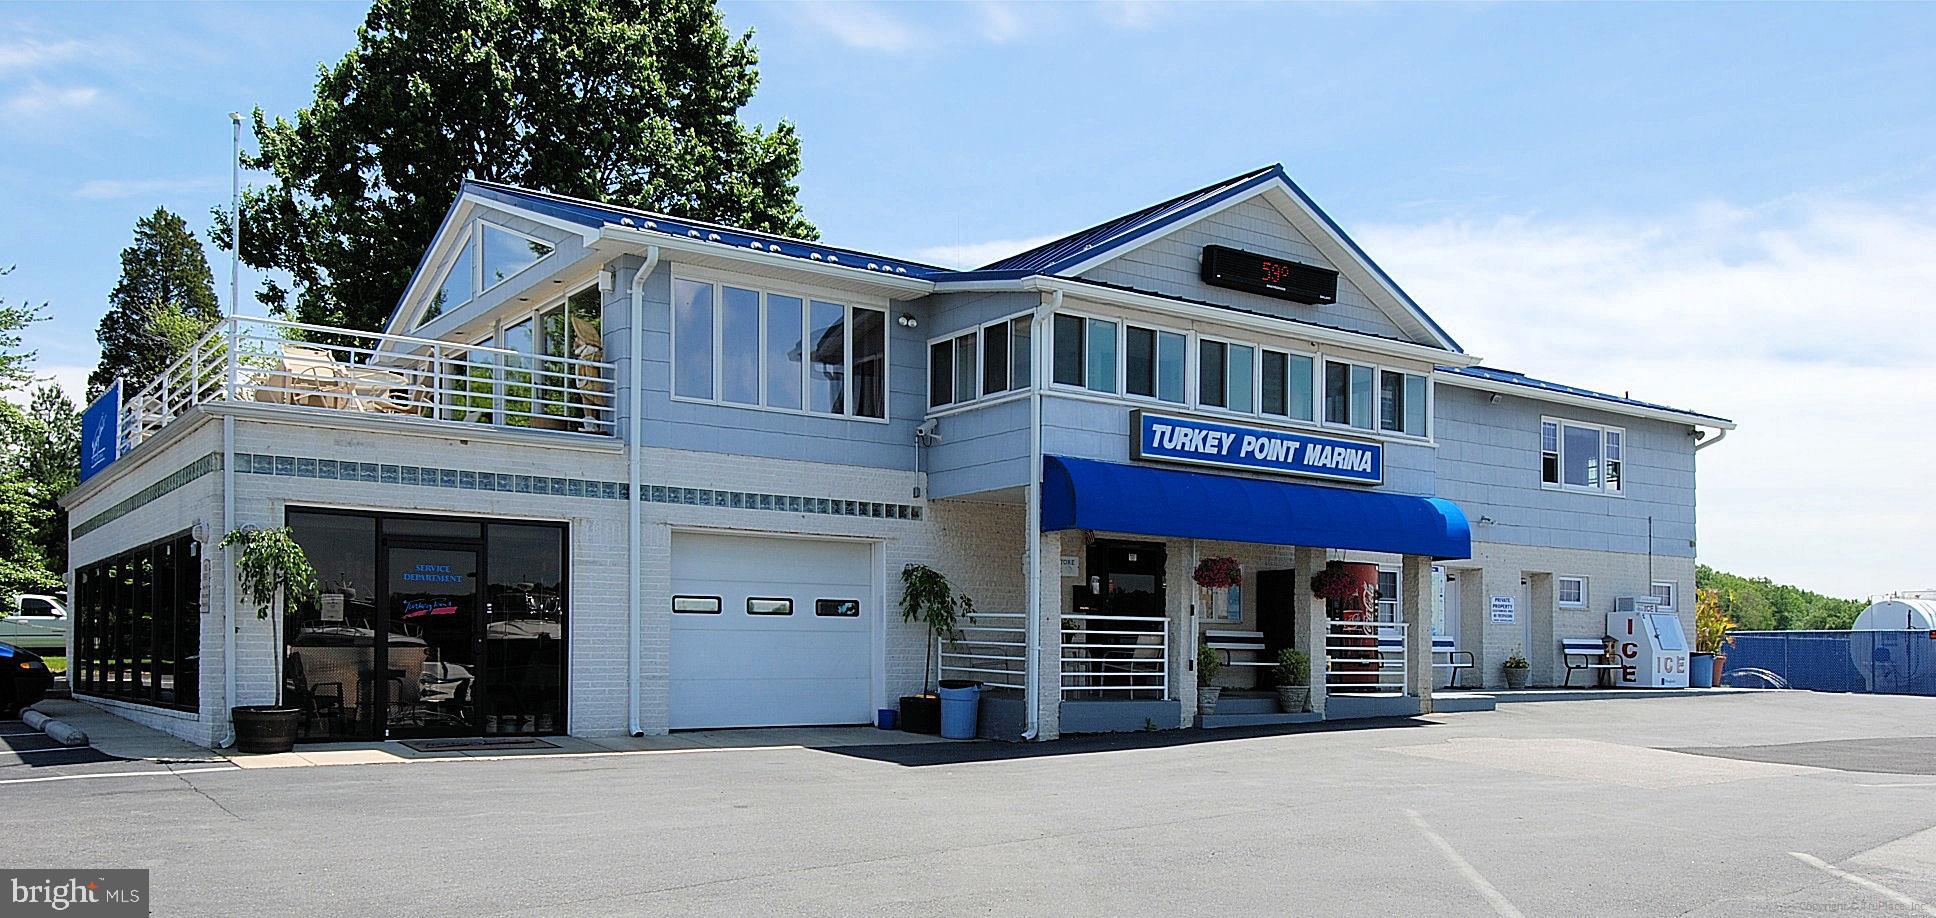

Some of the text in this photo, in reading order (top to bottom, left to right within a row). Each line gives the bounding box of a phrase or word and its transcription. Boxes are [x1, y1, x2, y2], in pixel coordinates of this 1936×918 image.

[1152, 424, 1372, 473] TURKEY POINT MARINA
[415, 564, 450, 572] SERVICE
[403, 574, 463, 582] DEPARTMENT
[1621, 618, 1638, 683] ICE
[1656, 655, 1685, 674] ICE
